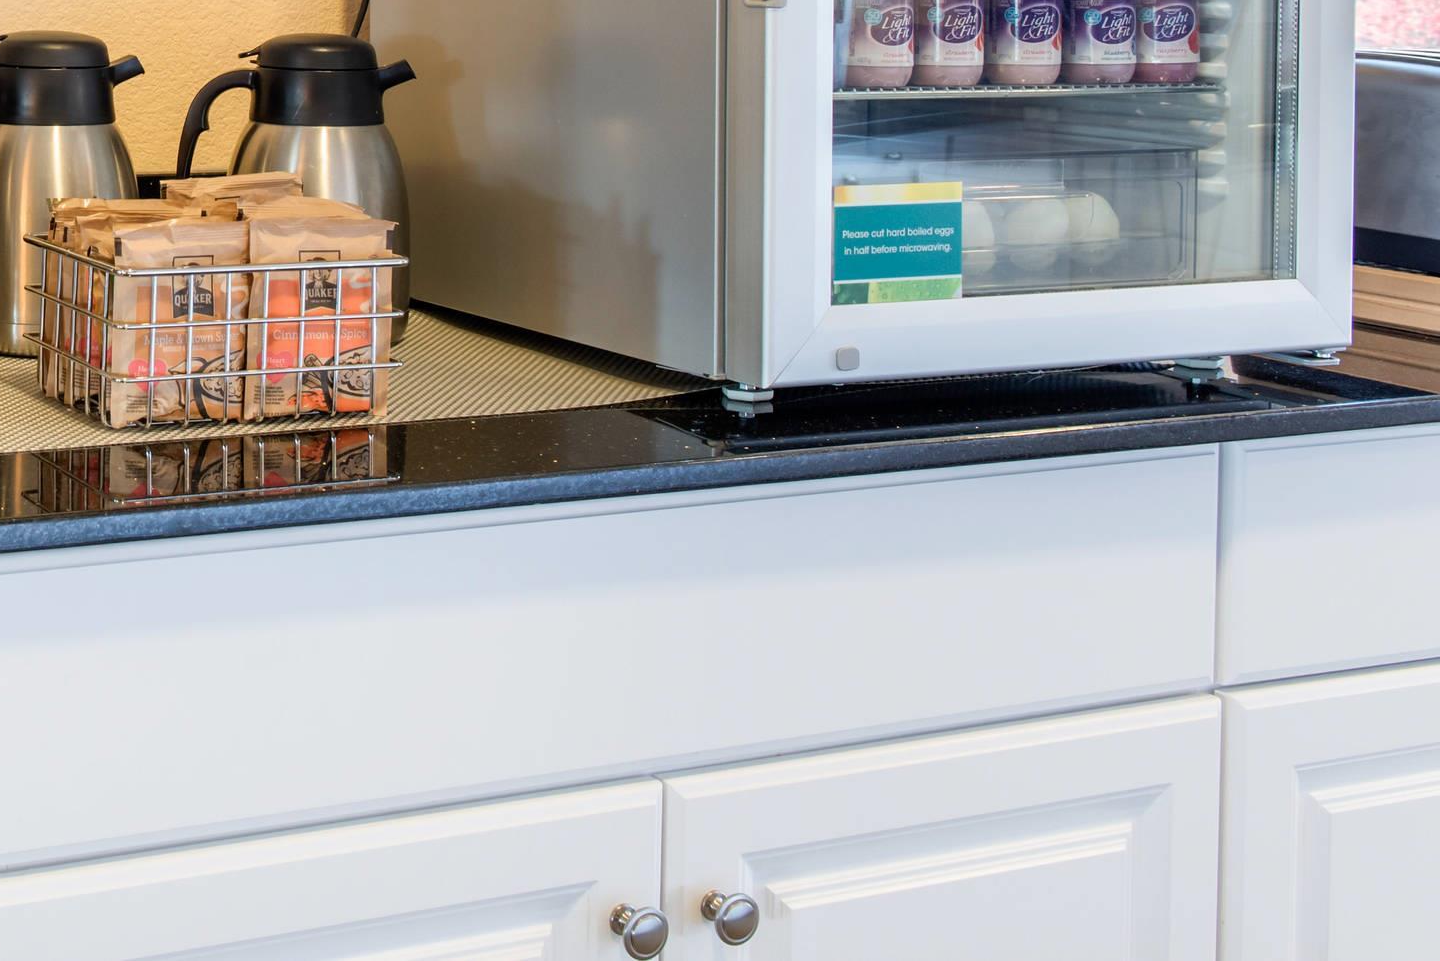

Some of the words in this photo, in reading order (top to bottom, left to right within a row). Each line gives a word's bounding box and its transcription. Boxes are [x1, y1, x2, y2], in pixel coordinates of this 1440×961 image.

[882, 14, 911, 29] Light
[944, 12, 977, 28] Light
[1022, 11, 1055, 28] Light
[1102, 13, 1132, 29] Light
[1154, 12, 1188, 28] Light
[896, 26, 909, 39] Fit
[960, 25, 976, 37] Fit
[1038, 24, 1053, 36] Fit
[1116, 26, 1130, 38] Fit
[1170, 25, 1187, 36] Fit
[842, 229, 869, 239] Please
[871, 228, 885, 238] cut
[886, 227, 906, 237] hard
[907, 226, 933, 237] boiled
[934, 227, 954, 237] eggs
[844, 246, 852, 255] in
[854, 245, 870, 255] half
[871, 244, 898, 254] before
[899, 242, 953, 254] microwaving.
[272, 329, 329, 340] Cinnmon
